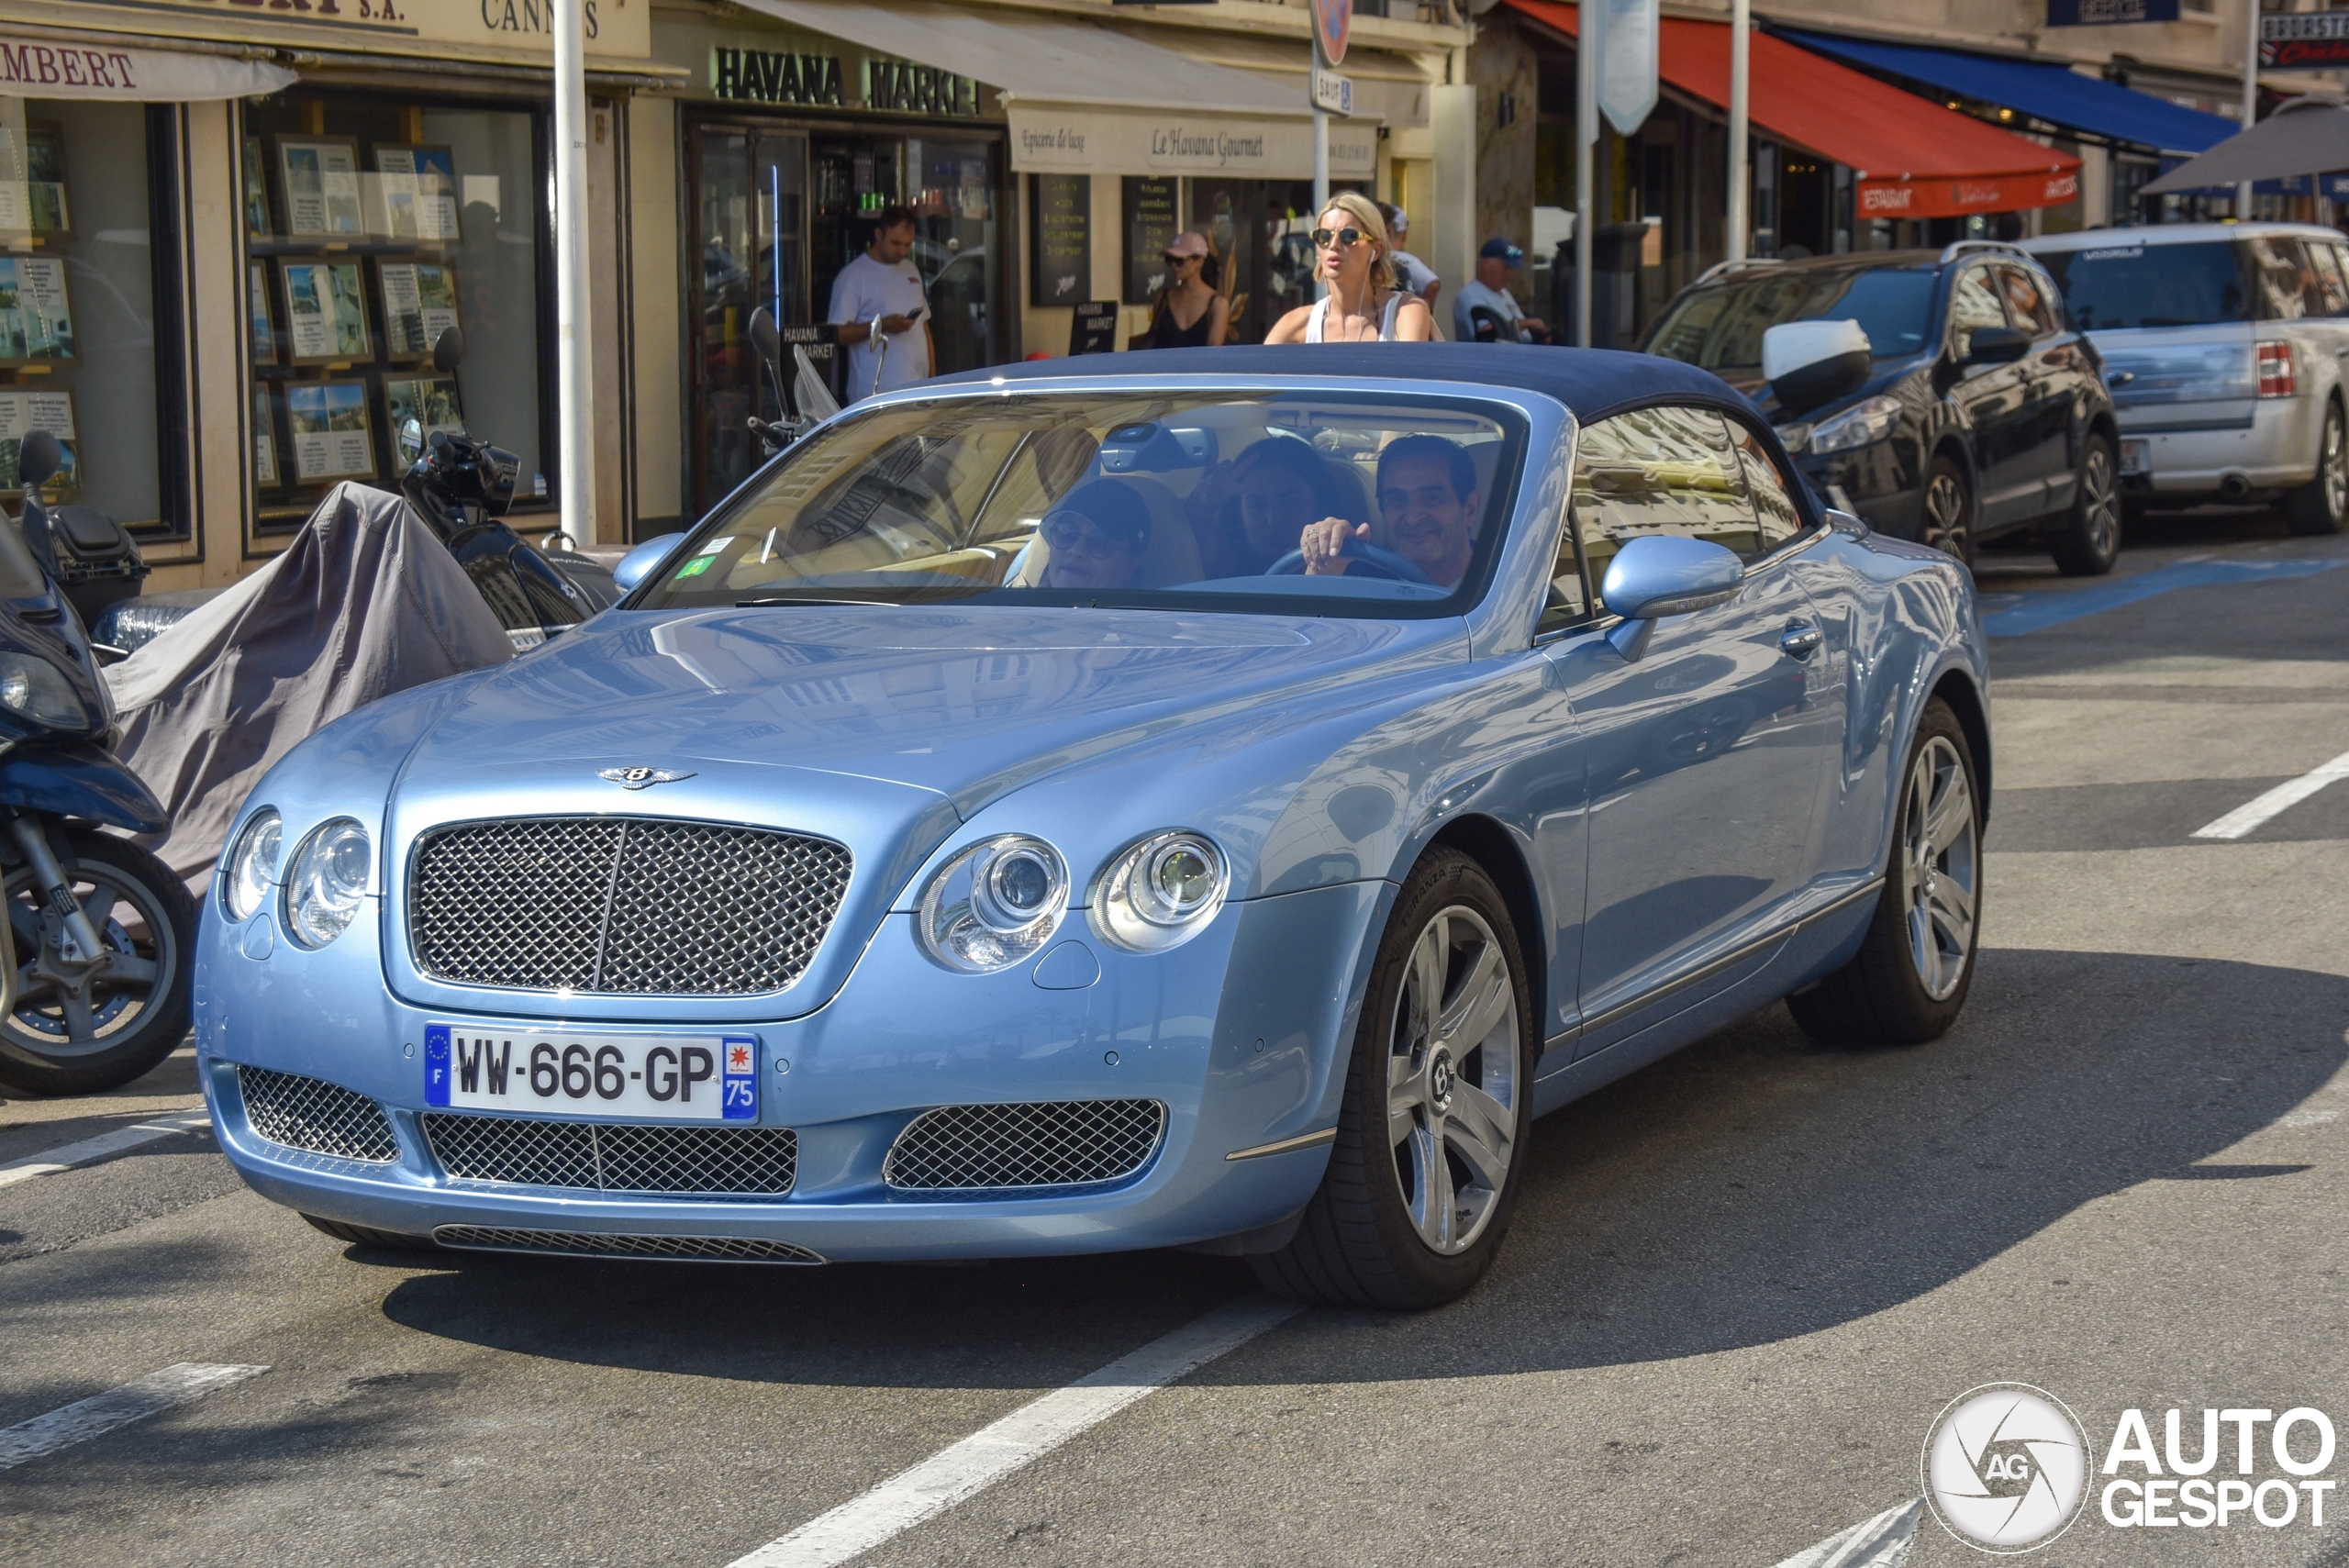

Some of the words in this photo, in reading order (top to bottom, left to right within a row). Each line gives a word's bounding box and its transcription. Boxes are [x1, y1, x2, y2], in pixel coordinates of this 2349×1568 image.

[0, 42, 137, 89] MBERT
[717, 48, 843, 106] HAVANA
[1320, 77, 1339, 101] SAUF
[1022, 129, 1054, 154] Epicerie
[1058, 128, 1066, 149] de
[1069, 128, 1085, 154] luxe
[1152, 128, 1167, 155] Le
[1170, 128, 1214, 156] Havana
[1219, 130, 1264, 166] Gourmet
[1077, 303, 1103, 316] HAVANA
[785, 327, 818, 342] HAVANA
[1086, 317, 1114, 330] MARKET
[1401, 868, 1447, 927] TURANZA
[434, 1069, 442, 1084] F
[457, 1038, 714, 1103] WW-666-GP
[727, 1080, 753, 1106] 75
